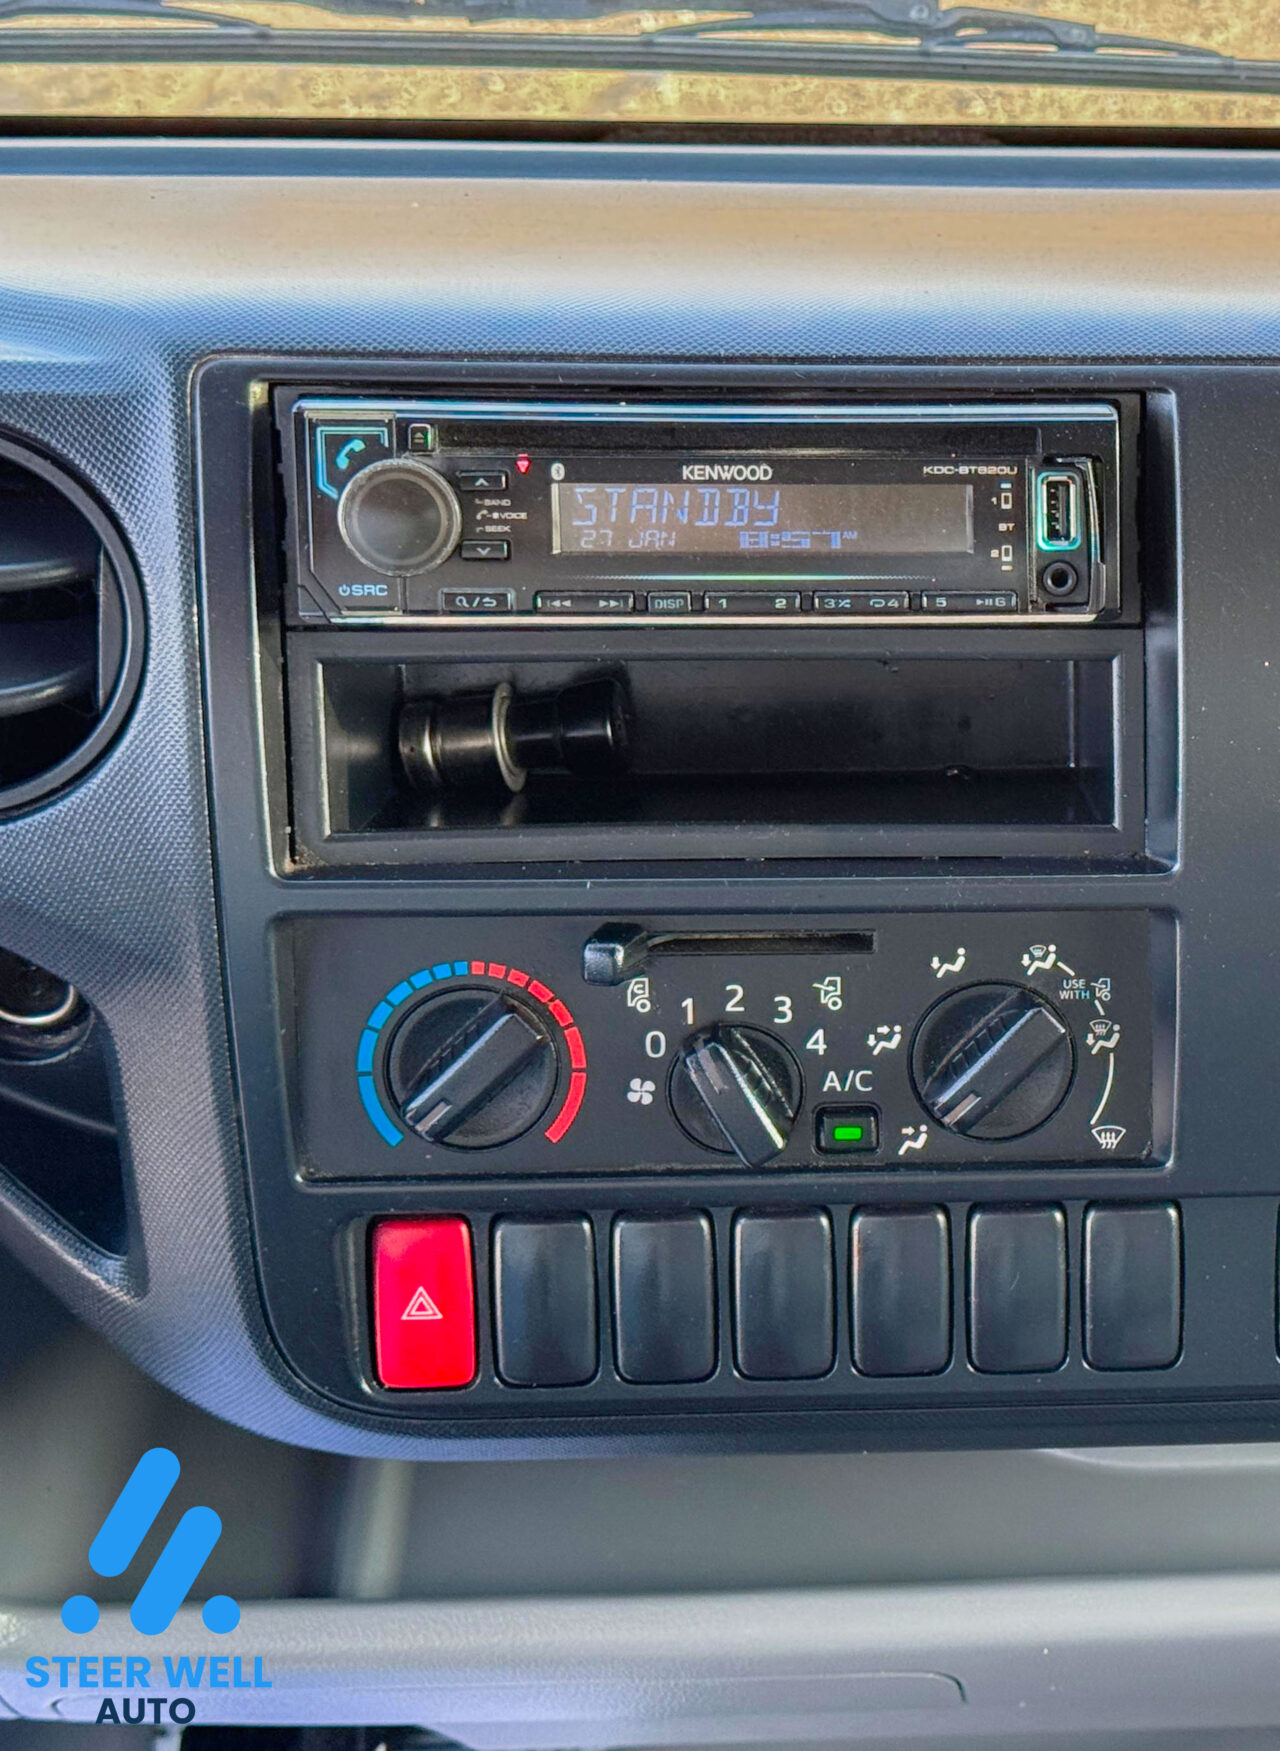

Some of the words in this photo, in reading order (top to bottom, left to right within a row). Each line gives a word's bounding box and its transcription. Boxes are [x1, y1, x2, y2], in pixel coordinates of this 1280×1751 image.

[682, 464, 773, 481] KENWOOD
[484, 499, 511, 507] BAND
[572, 487, 780, 526] STANDBY
[500, 512, 528, 520] VOICE
[581, 530, 613, 549] 27
[628, 530, 676, 549] JAN
[351, 584, 388, 596] SRC
[654, 598, 684, 609] DISP
[718, 598, 728, 609] 1
[774, 598, 787, 609] 2
[824, 598, 836, 609] 3
[886, 598, 900, 609] 4
[936, 598, 948, 609] 5
[1063, 979, 1086, 989] USE
[724, 984, 746, 1012] 2
[1059, 990, 1090, 1000] WITH
[681, 998, 695, 1025] 1
[772, 996, 793, 1024] 3
[645, 1030, 667, 1059] 0
[805, 1029, 828, 1056] 4
[822, 1069, 874, 1093] A/C
